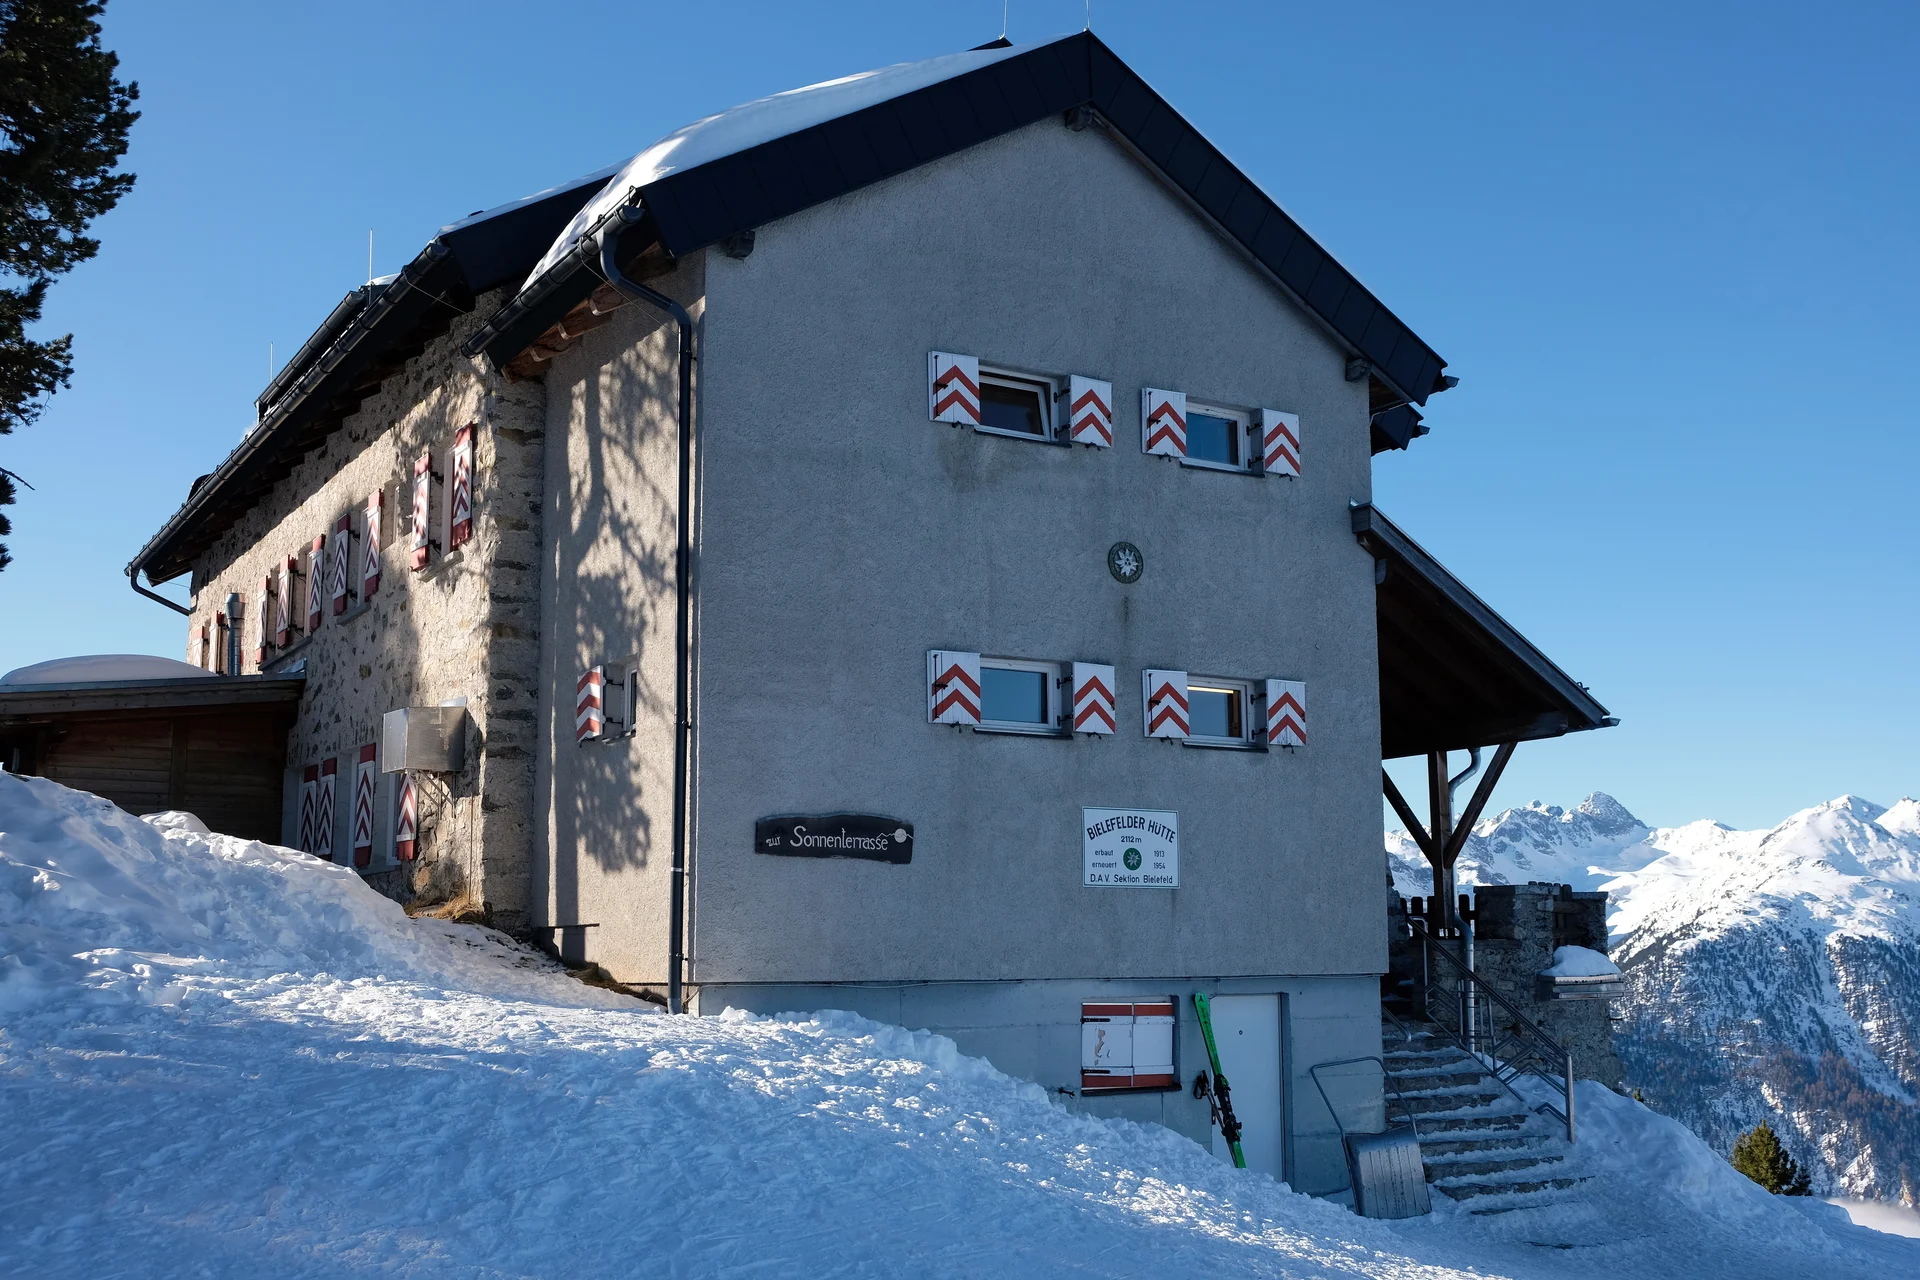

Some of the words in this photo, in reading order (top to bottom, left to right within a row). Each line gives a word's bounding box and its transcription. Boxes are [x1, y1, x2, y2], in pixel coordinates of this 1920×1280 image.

[766, 836, 780, 846] zur
[790, 825, 888, 850] Sonnenterrasse
[1086, 816, 1146, 840] BIELEFELDER
[1148, 820, 1176, 843] HÜTTE
[1090, 874, 1110, 882] D.A.V.
[1114, 874, 1140, 883] Sektion
[1144, 875, 1172, 884] Bielefeld
